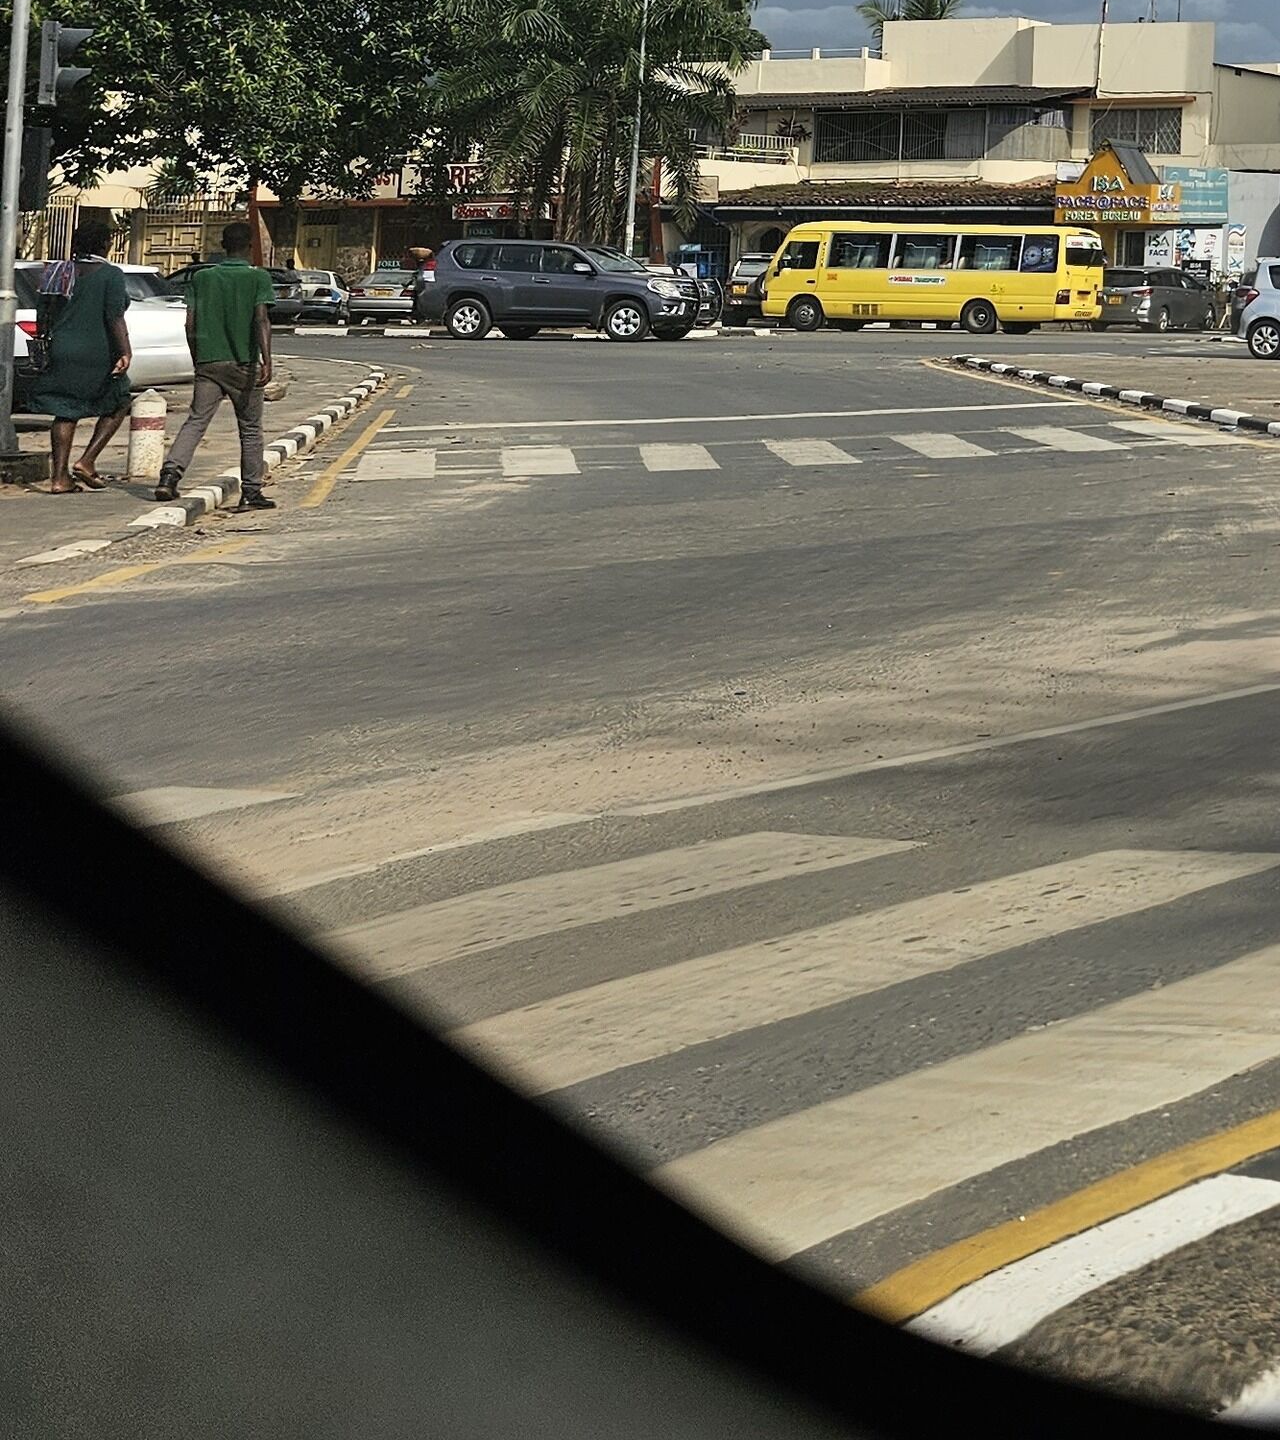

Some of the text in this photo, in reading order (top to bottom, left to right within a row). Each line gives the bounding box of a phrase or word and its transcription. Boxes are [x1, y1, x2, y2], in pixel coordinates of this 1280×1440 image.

[1064, 210, 1099, 221] FOREX
[1101, 210, 1142, 220] BUREAU
[1149, 249, 1169, 257] FACE
